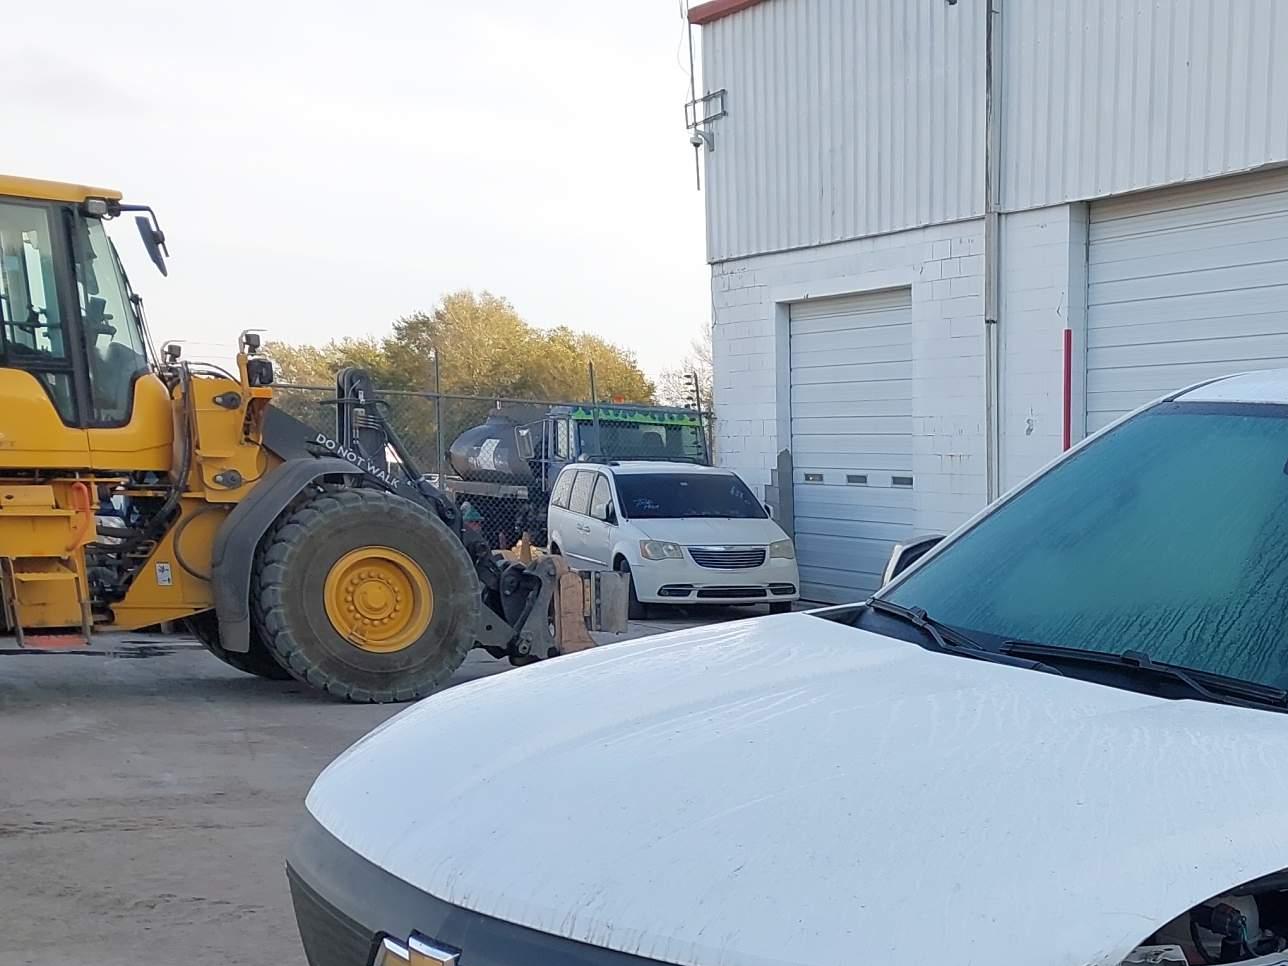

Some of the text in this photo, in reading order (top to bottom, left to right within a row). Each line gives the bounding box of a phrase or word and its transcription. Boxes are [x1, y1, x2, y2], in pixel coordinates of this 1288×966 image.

[316, 433, 400, 488] DO NOT WALK
